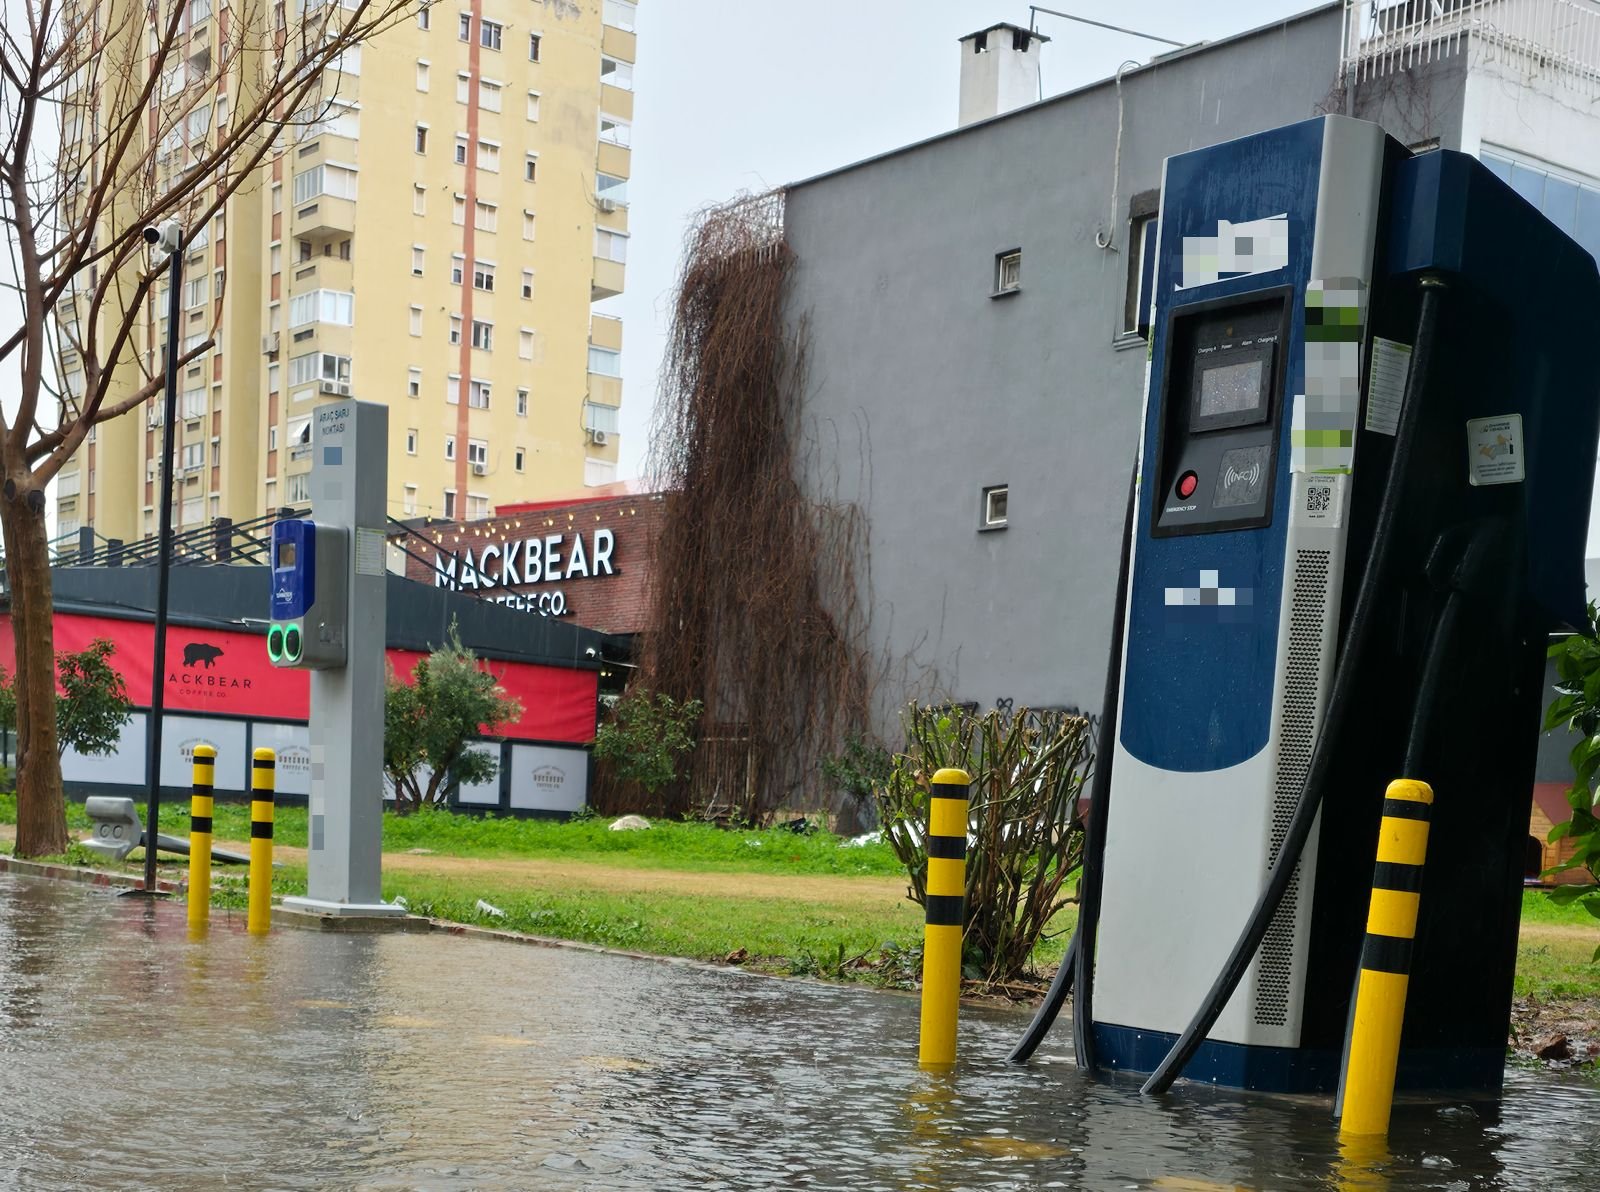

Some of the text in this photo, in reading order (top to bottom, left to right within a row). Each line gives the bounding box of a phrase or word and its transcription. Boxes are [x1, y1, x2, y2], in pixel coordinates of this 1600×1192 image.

[1233, 470, 1250, 482] NFC
[435, 528, 615, 591] MACKBEAR
[169, 673, 252, 690] ACKBEAR
